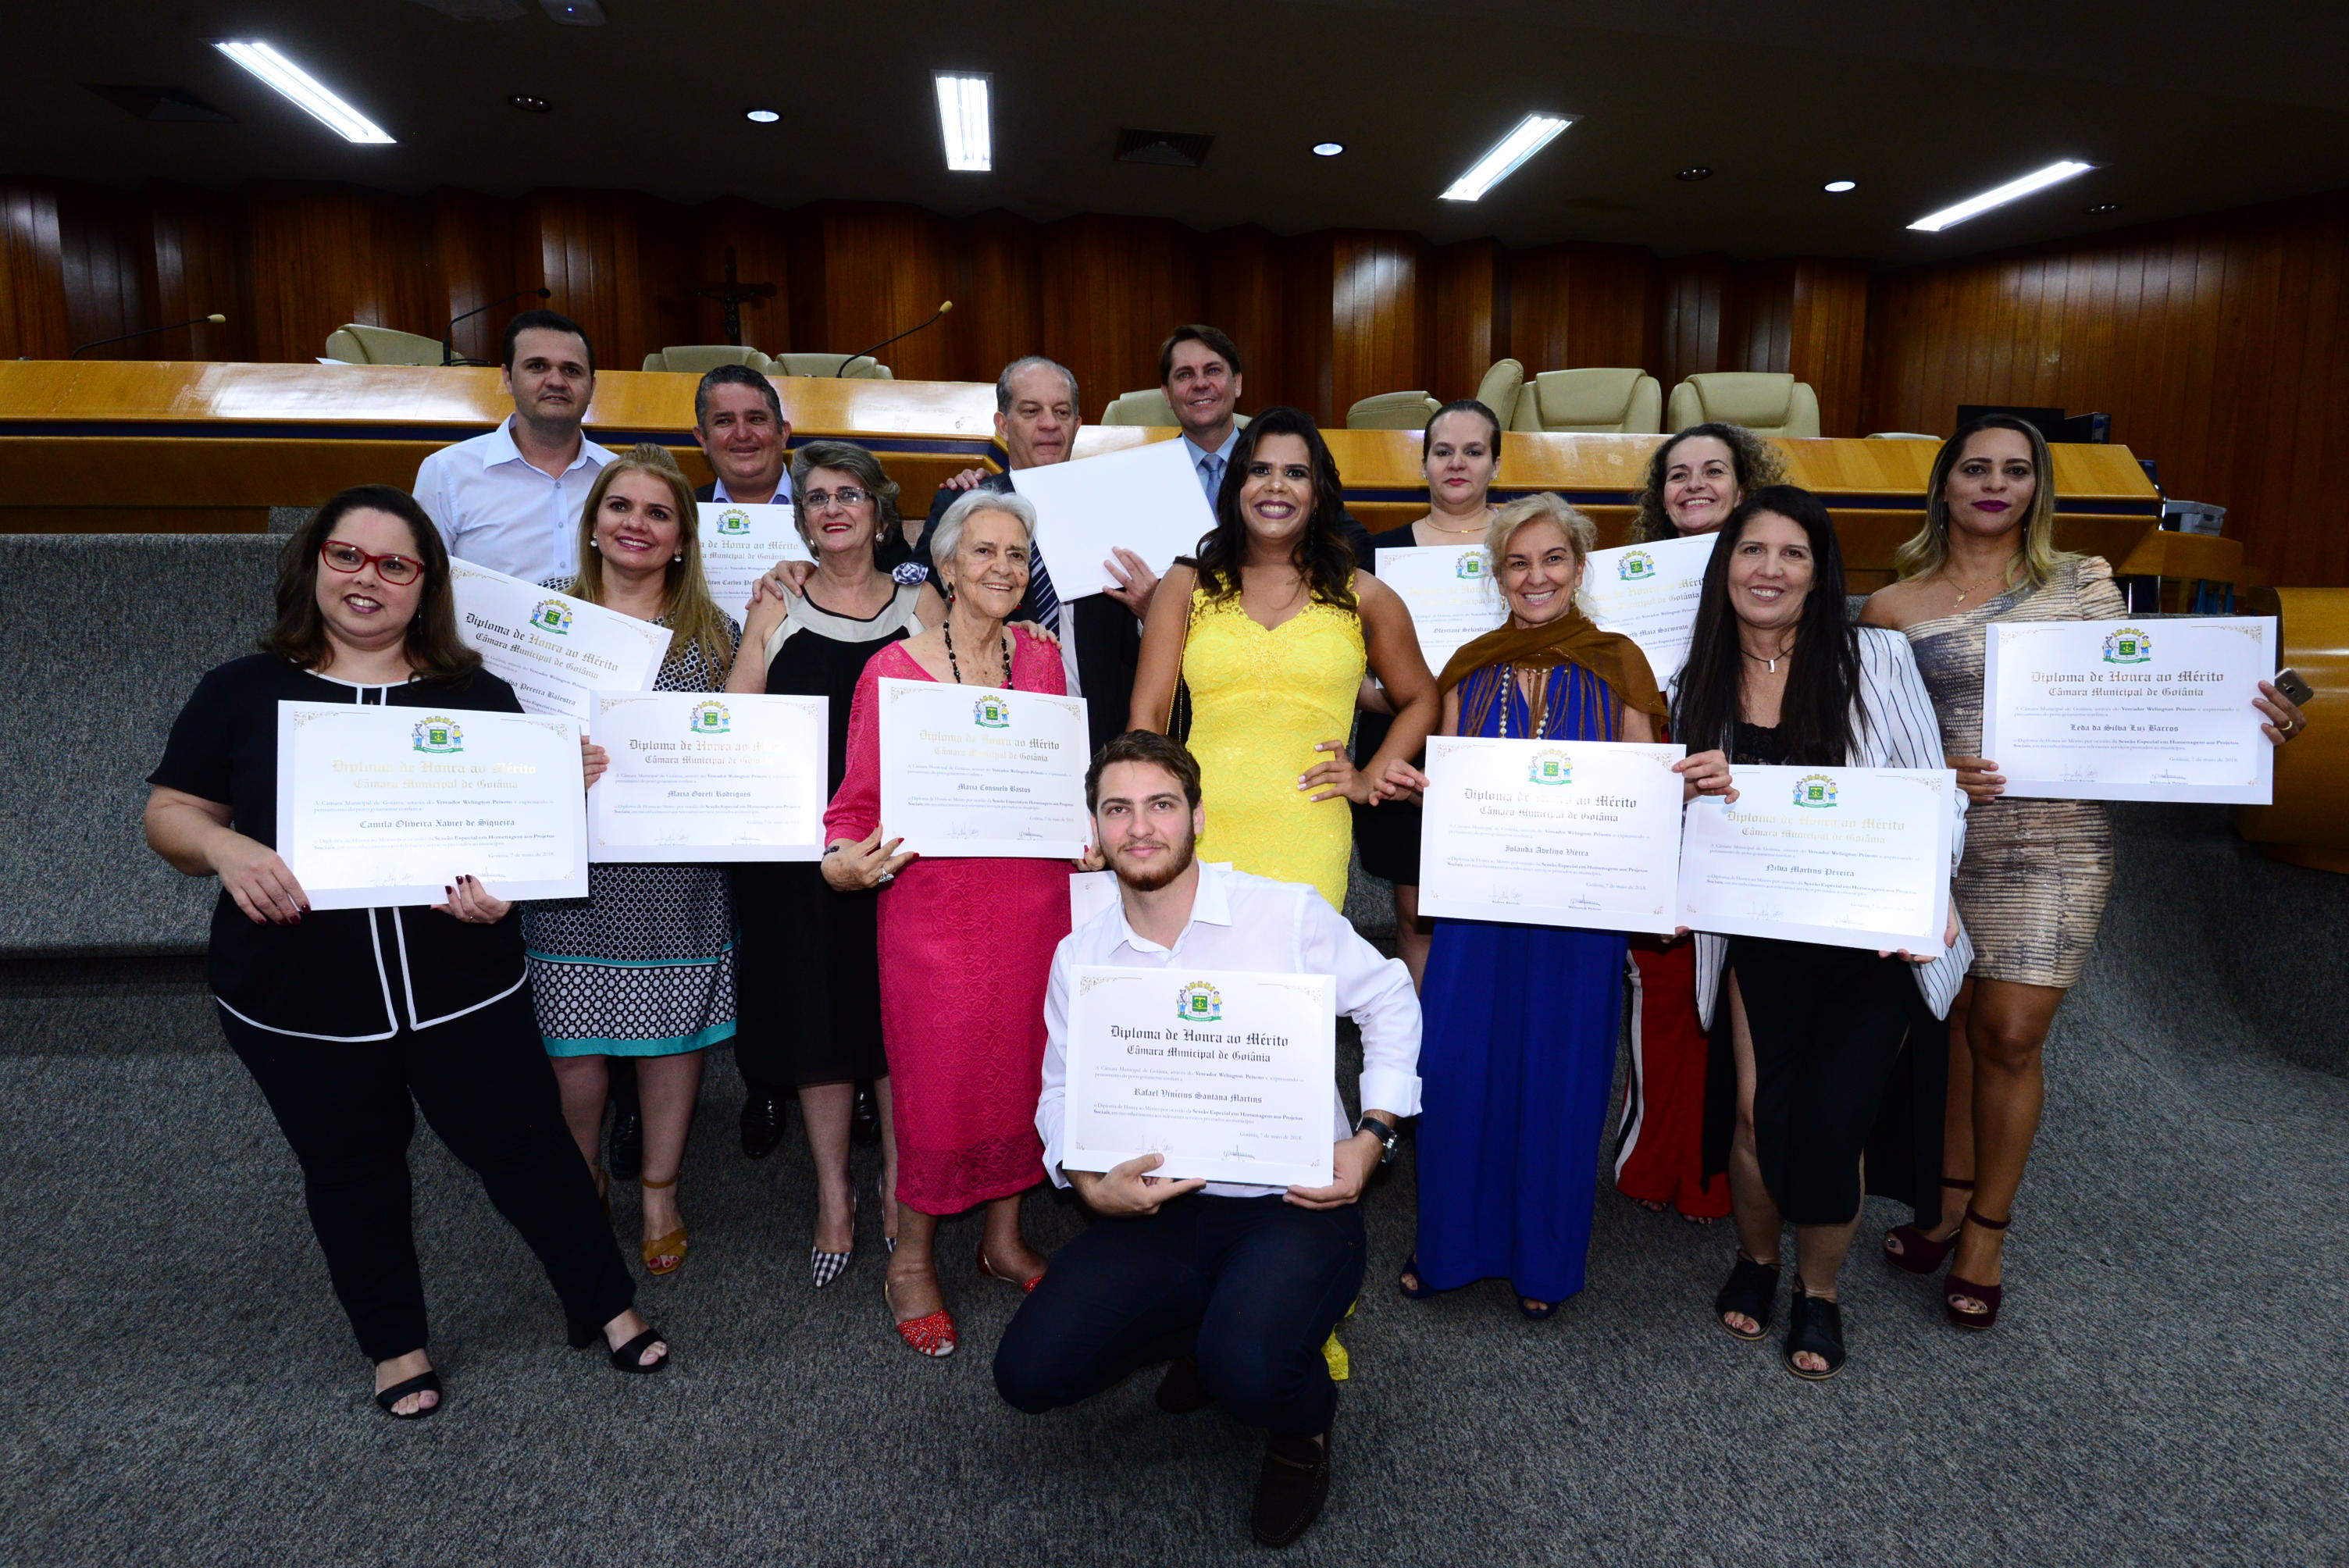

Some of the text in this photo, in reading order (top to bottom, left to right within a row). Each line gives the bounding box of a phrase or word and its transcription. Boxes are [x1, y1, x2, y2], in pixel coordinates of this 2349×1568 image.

[708, 540, 718, 548] de
[722, 540, 750, 549] Honra
[768, 540, 797, 550] Mérito
[1677, 578, 1704, 589] Méri
[1669, 592, 1699, 601] Goiânia
[1658, 625, 1688, 633] Sarmento
[466, 613, 618, 672] Diploma de Honra ao Mérito
[476, 633, 599, 679] Câmara Municipal de Goiânia
[2031, 672, 2084, 684] Diploma
[2091, 672, 2103, 682] de
[2110, 672, 2151, 682] Honra
[2178, 671, 2223, 682] Mérito
[519, 682, 545, 696] Pereira
[547, 691, 576, 706] Balestra
[2048, 688, 2204, 698] Câmara Municipal de Goiânia
[630, 739, 675, 752] Diploma
[680, 740, 691, 750] de
[697, 740, 730, 751] Honra
[1028, 738, 1059, 750] Mérito
[645, 755, 678, 764] Câmara
[682, 756, 724, 765] Municipal
[1019, 753, 1047, 762] Goiânia
[333, 760, 536, 775] Diploma de Honra ao Mérito
[353, 779, 519, 790] Câmara Municipal de Goiânia
[958, 782, 978, 791] Maria
[979, 784, 1007, 793] Consuelo
[1465, 788, 1513, 804] Diploma
[1595, 795, 1636, 809] Mérito
[1480, 806, 1618, 822] Câmara Municipal de Goiânia
[359, 820, 392, 829] Camila
[395, 819, 432, 828] Oliveira
[435, 819, 463, 828] Xavier
[477, 818, 515, 828] Siqueira
[1727, 811, 1776, 825] Diploma
[1861, 818, 1904, 831] Mérito
[1742, 827, 1777, 837] Câmara
[1505, 845, 1533, 853] Iolanda
[1535, 846, 1563, 856] Avelino
[1765, 864, 1855, 877] Nilva Martins Pereira
[1111, 1025, 1289, 1047] Diploma de Honra ao Mérito
[1127, 1045, 1271, 1063] Câmara Municipal de Goiânia
[1134, 1088, 1158, 1097] Rafael
[1195, 1092, 1228, 1102] Santana
[1230, 1093, 1262, 1103] Martins
